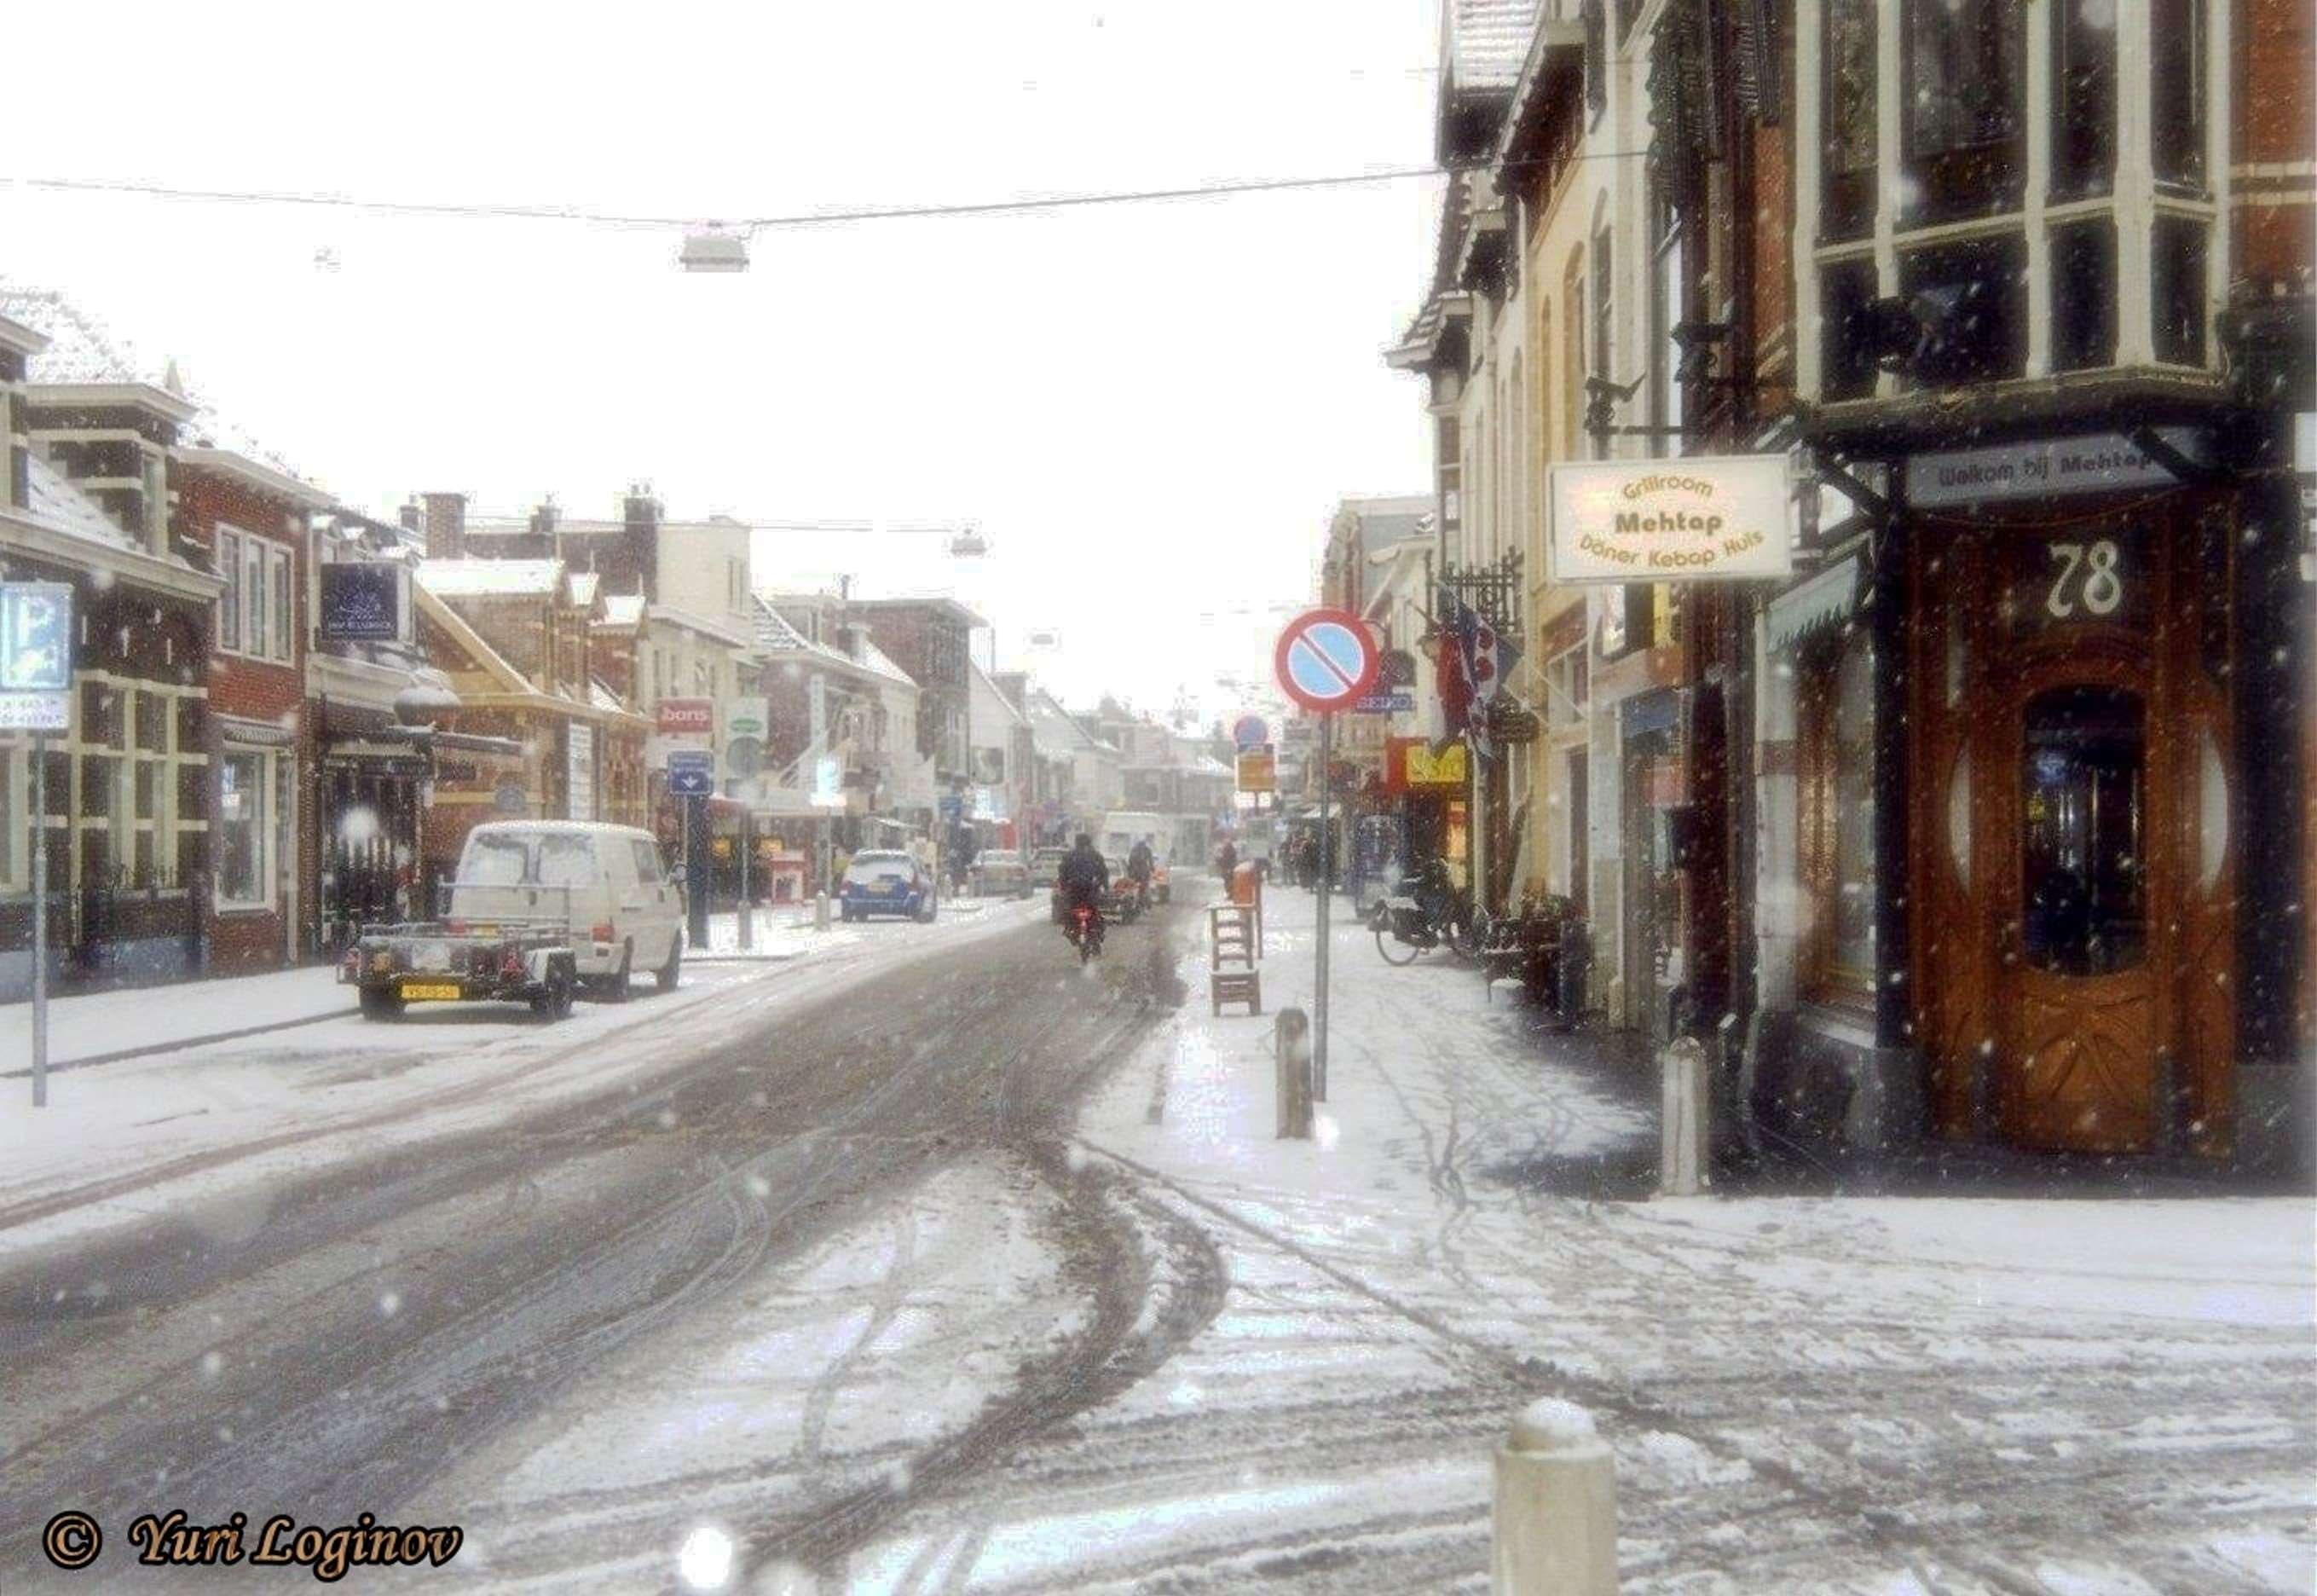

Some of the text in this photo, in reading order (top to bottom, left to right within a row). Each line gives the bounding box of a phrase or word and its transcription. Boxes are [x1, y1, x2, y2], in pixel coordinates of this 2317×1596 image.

[2024, 457, 2048, 480] bij
[2060, 451, 2152, 474] Mehtap
[1623, 477, 1713, 500] Grillroom
[1615, 512, 1723, 535] Mehtap
[1580, 534, 1640, 564] Döner
[1723, 529, 1765, 555] Huis
[2047, 541, 2121, 616] 78
